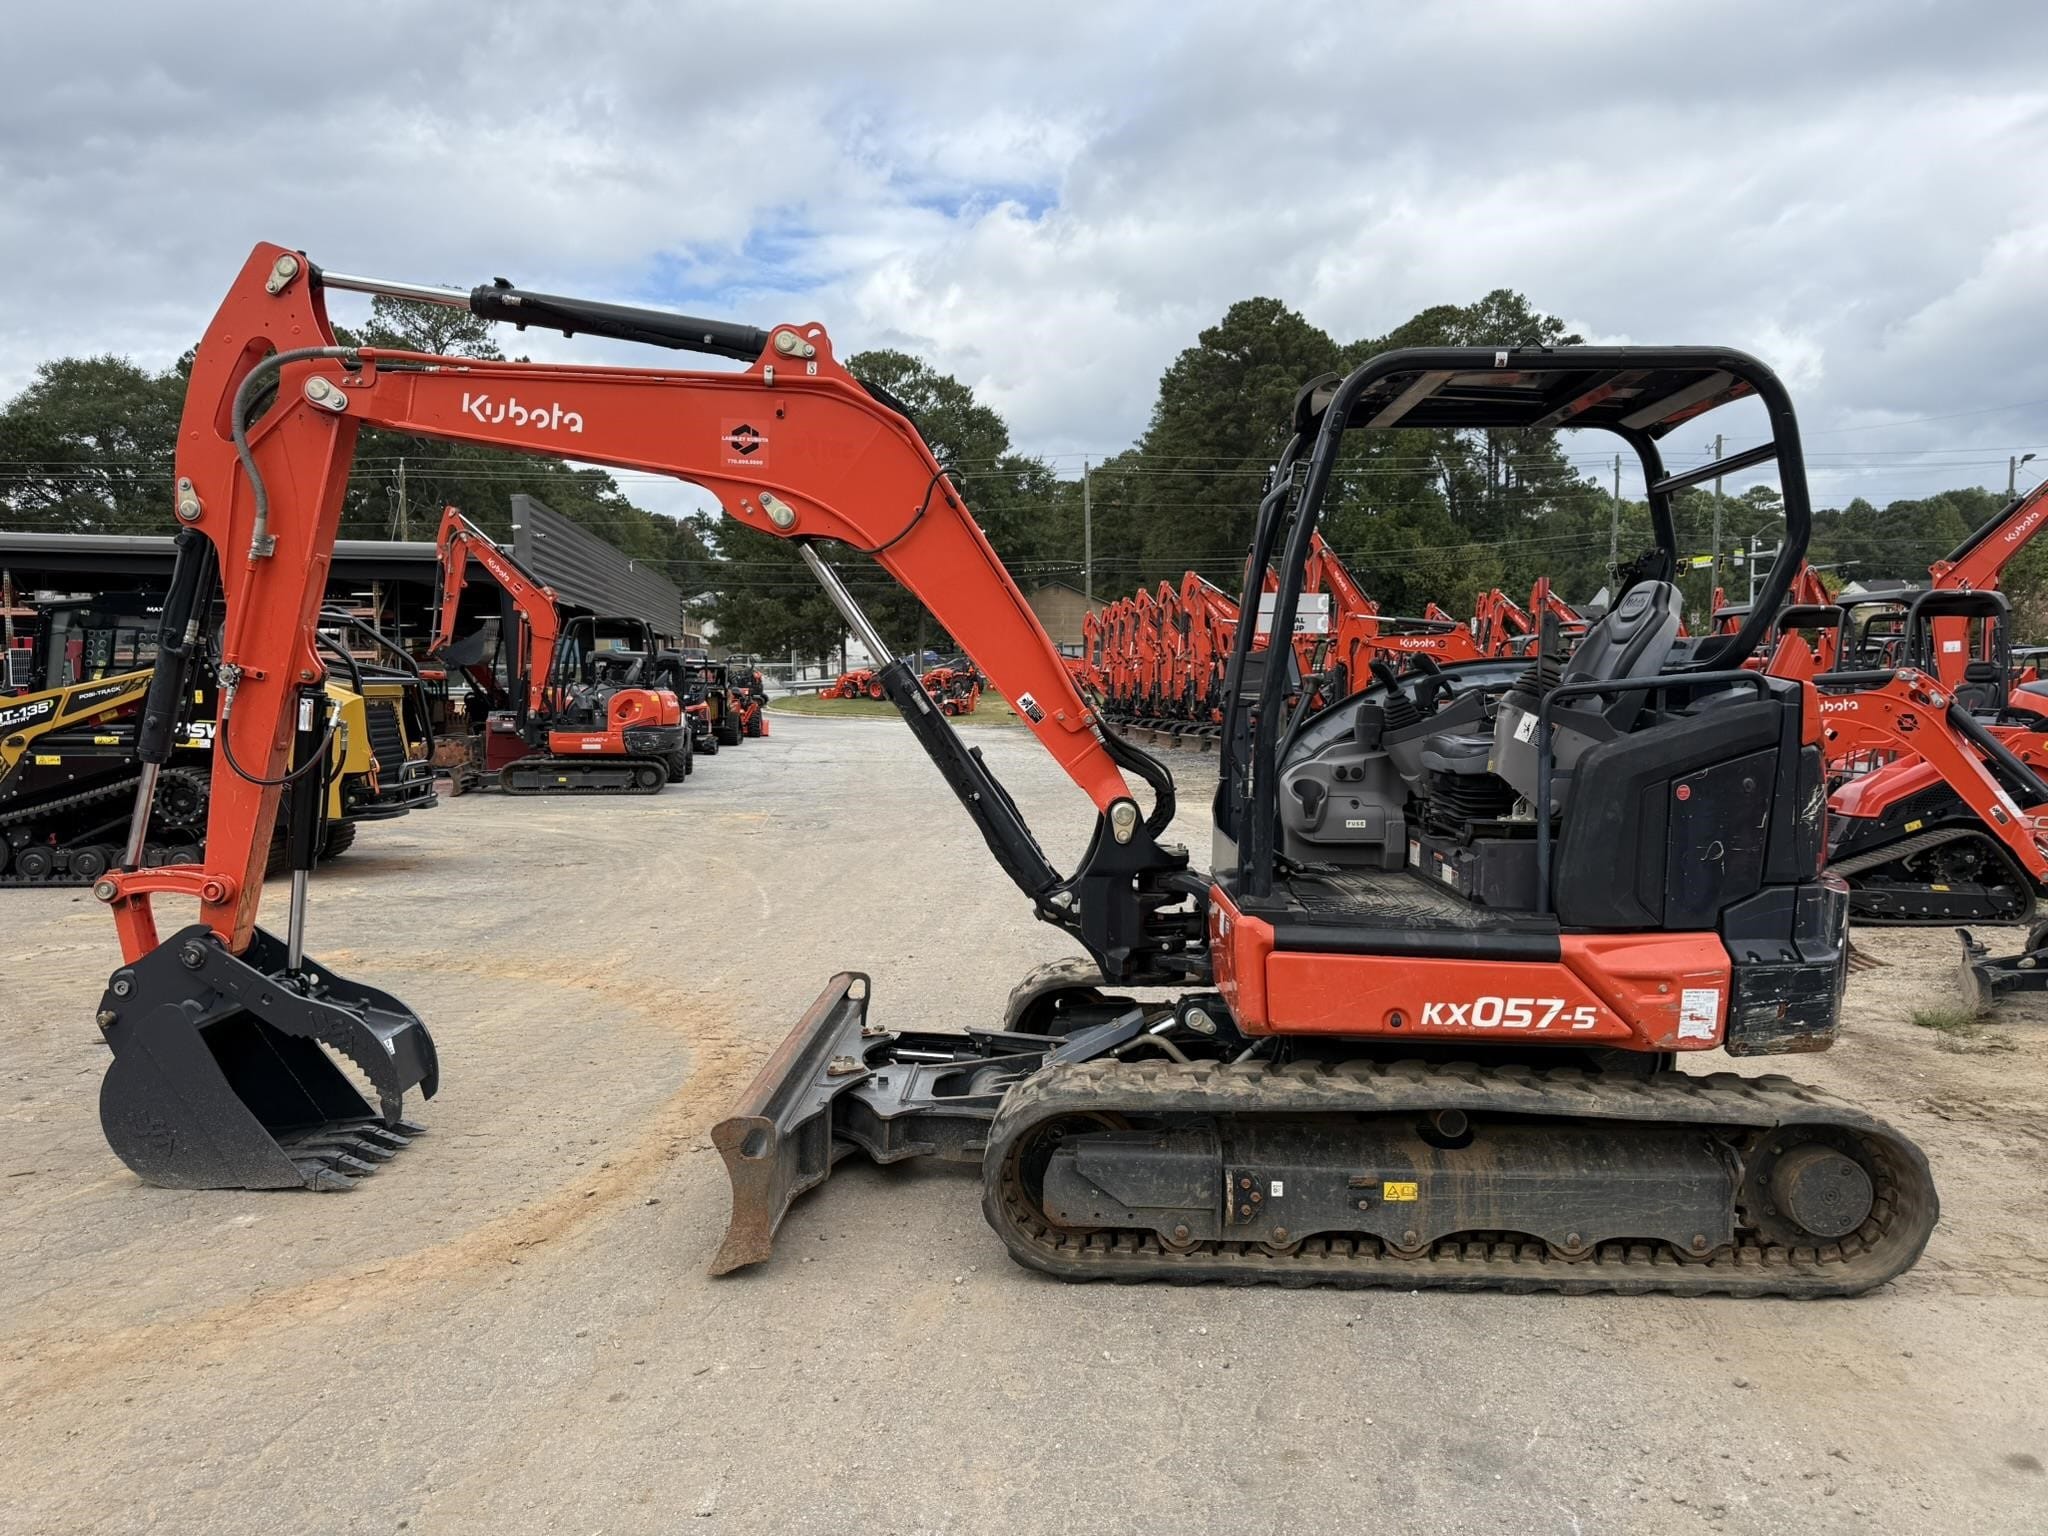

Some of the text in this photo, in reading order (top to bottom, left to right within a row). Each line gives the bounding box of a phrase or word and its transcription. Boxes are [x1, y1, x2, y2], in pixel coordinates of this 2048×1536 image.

[462, 392, 583, 433] Kubota
[2004, 512, 2040, 542] Kubota
[487, 557, 510, 582] Kubota
[1400, 638, 1436, 648] Kubota
[1420, 996, 1597, 1030] KX057-5
